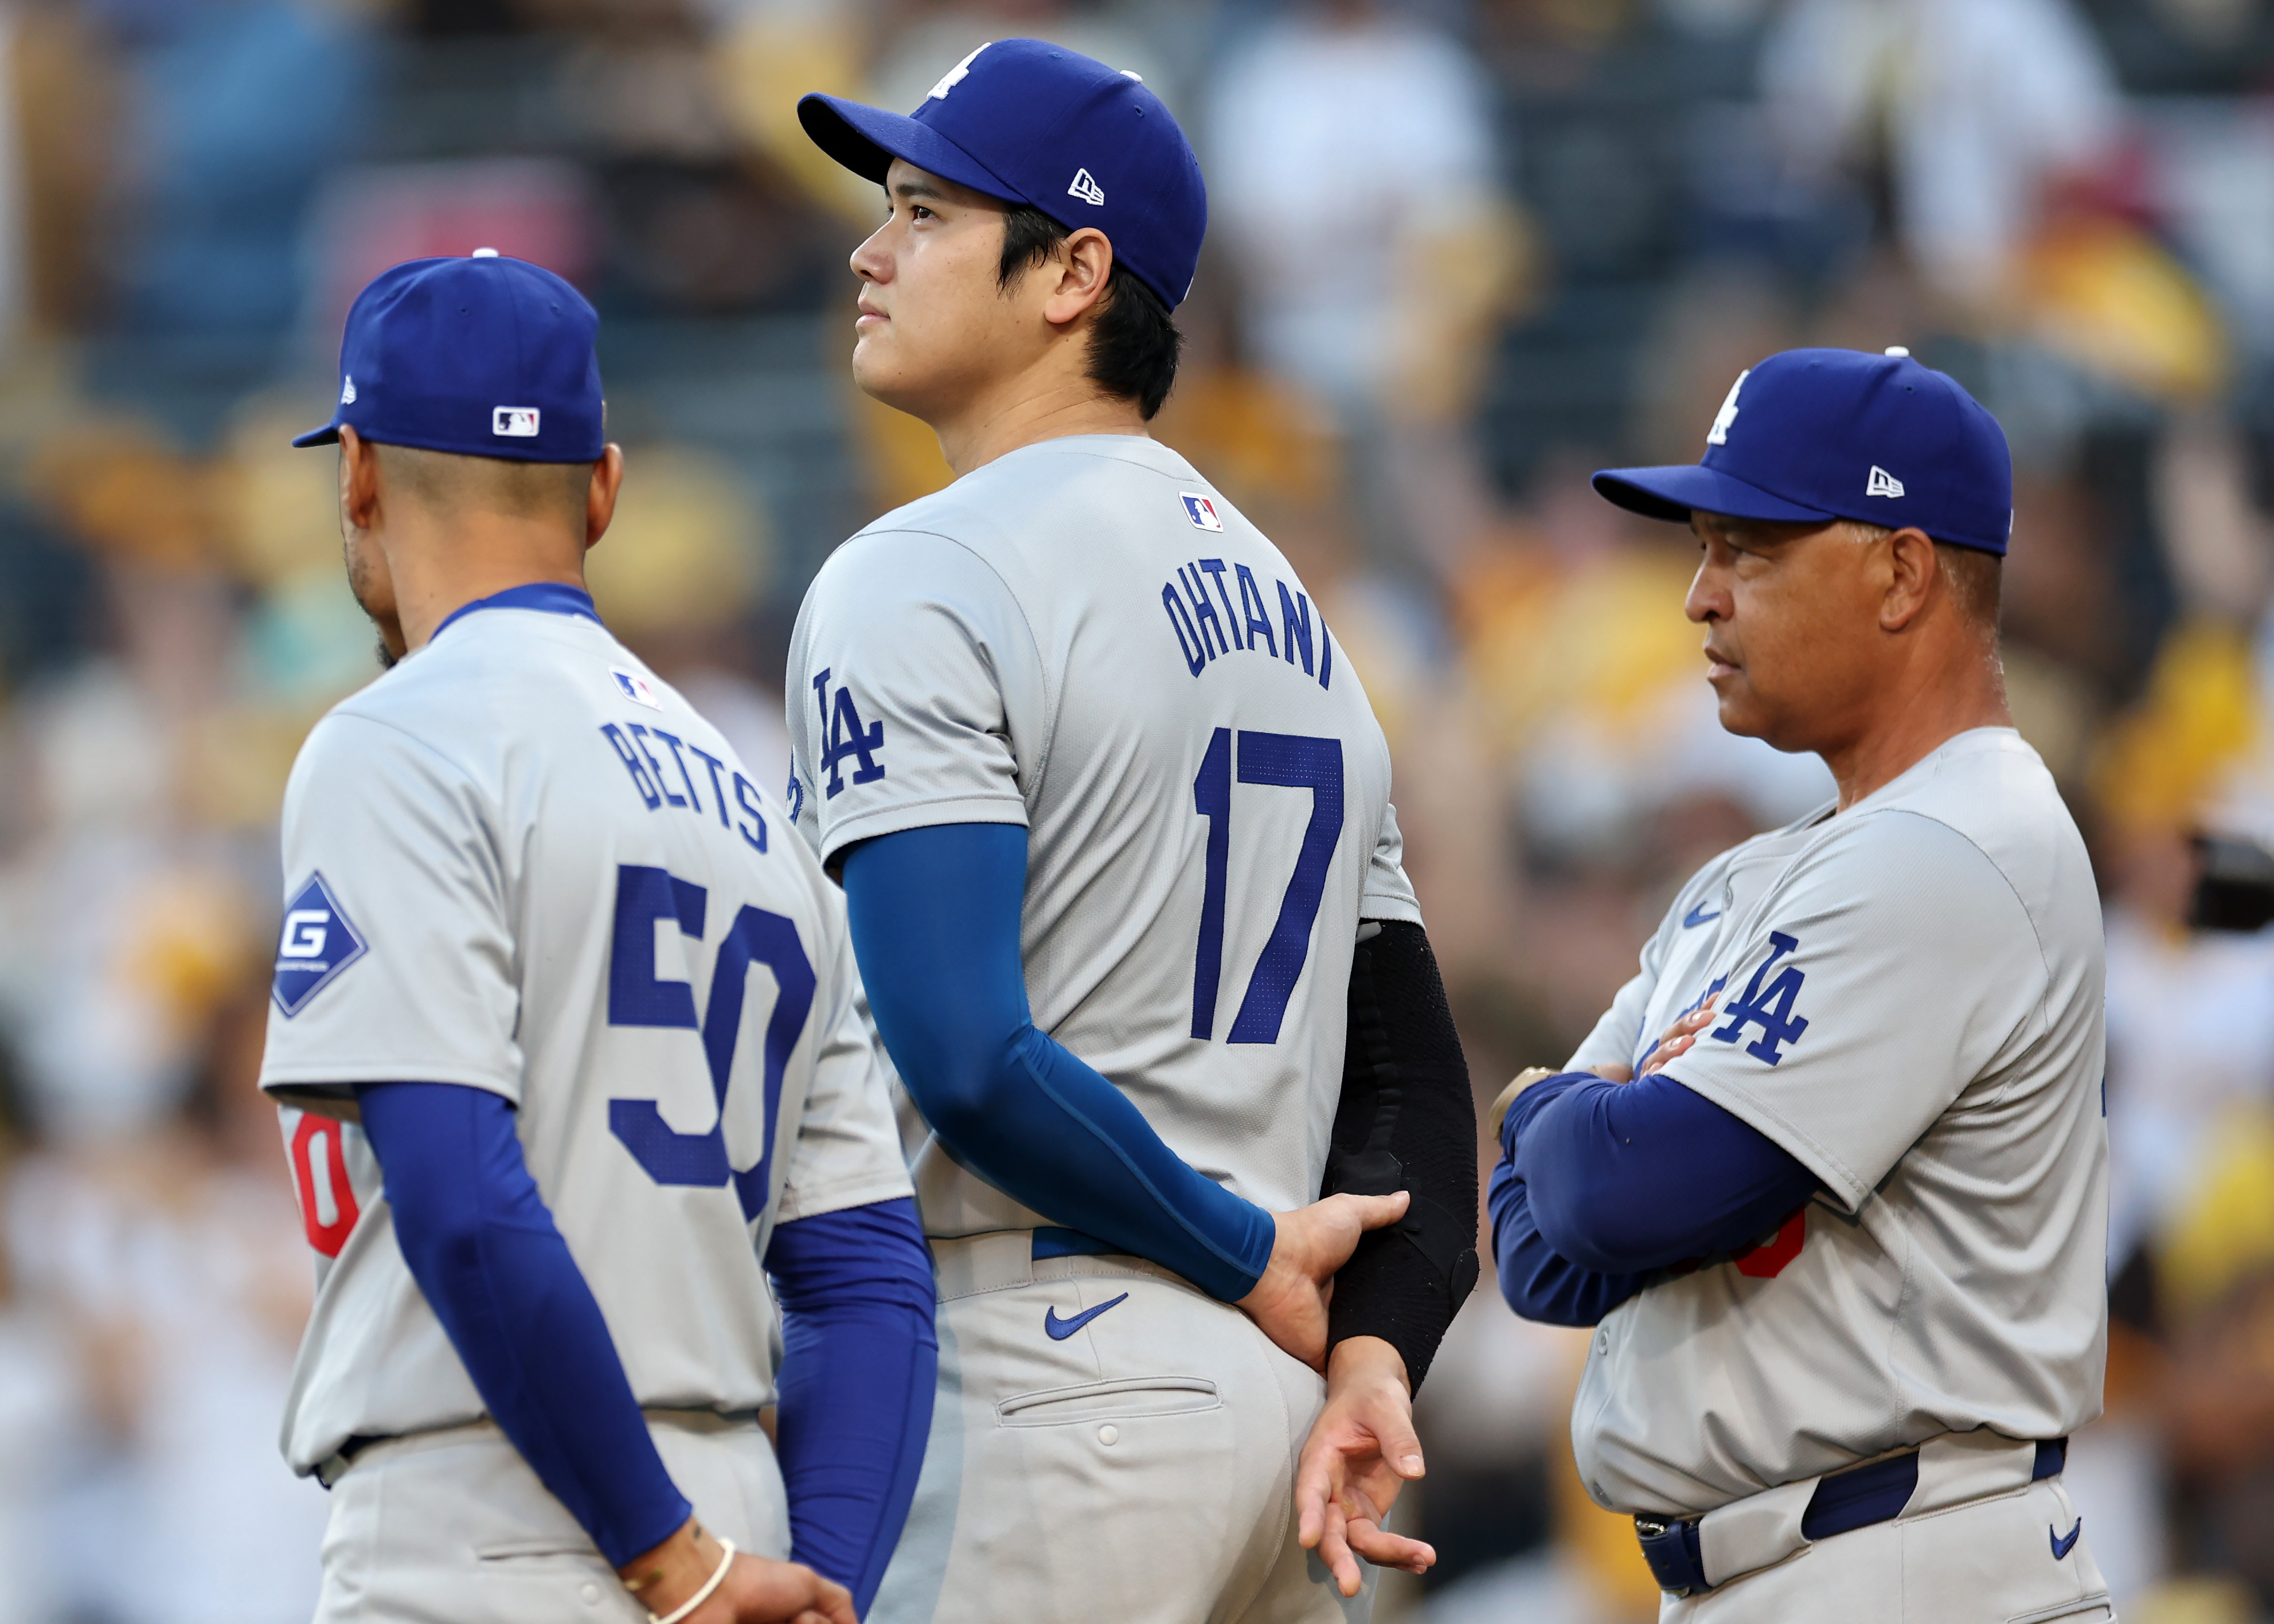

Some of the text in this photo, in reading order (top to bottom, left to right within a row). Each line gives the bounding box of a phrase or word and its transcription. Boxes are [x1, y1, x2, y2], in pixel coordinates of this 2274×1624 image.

[1162, 558, 1331, 691] OHTANI
[599, 723, 767, 855] BETTS
[813, 667, 885, 801] LA
[280, 909, 331, 958] G
[1191, 727, 1344, 1044] 17
[608, 864, 816, 1224] 50
[1711, 930, 1809, 1067] LA
